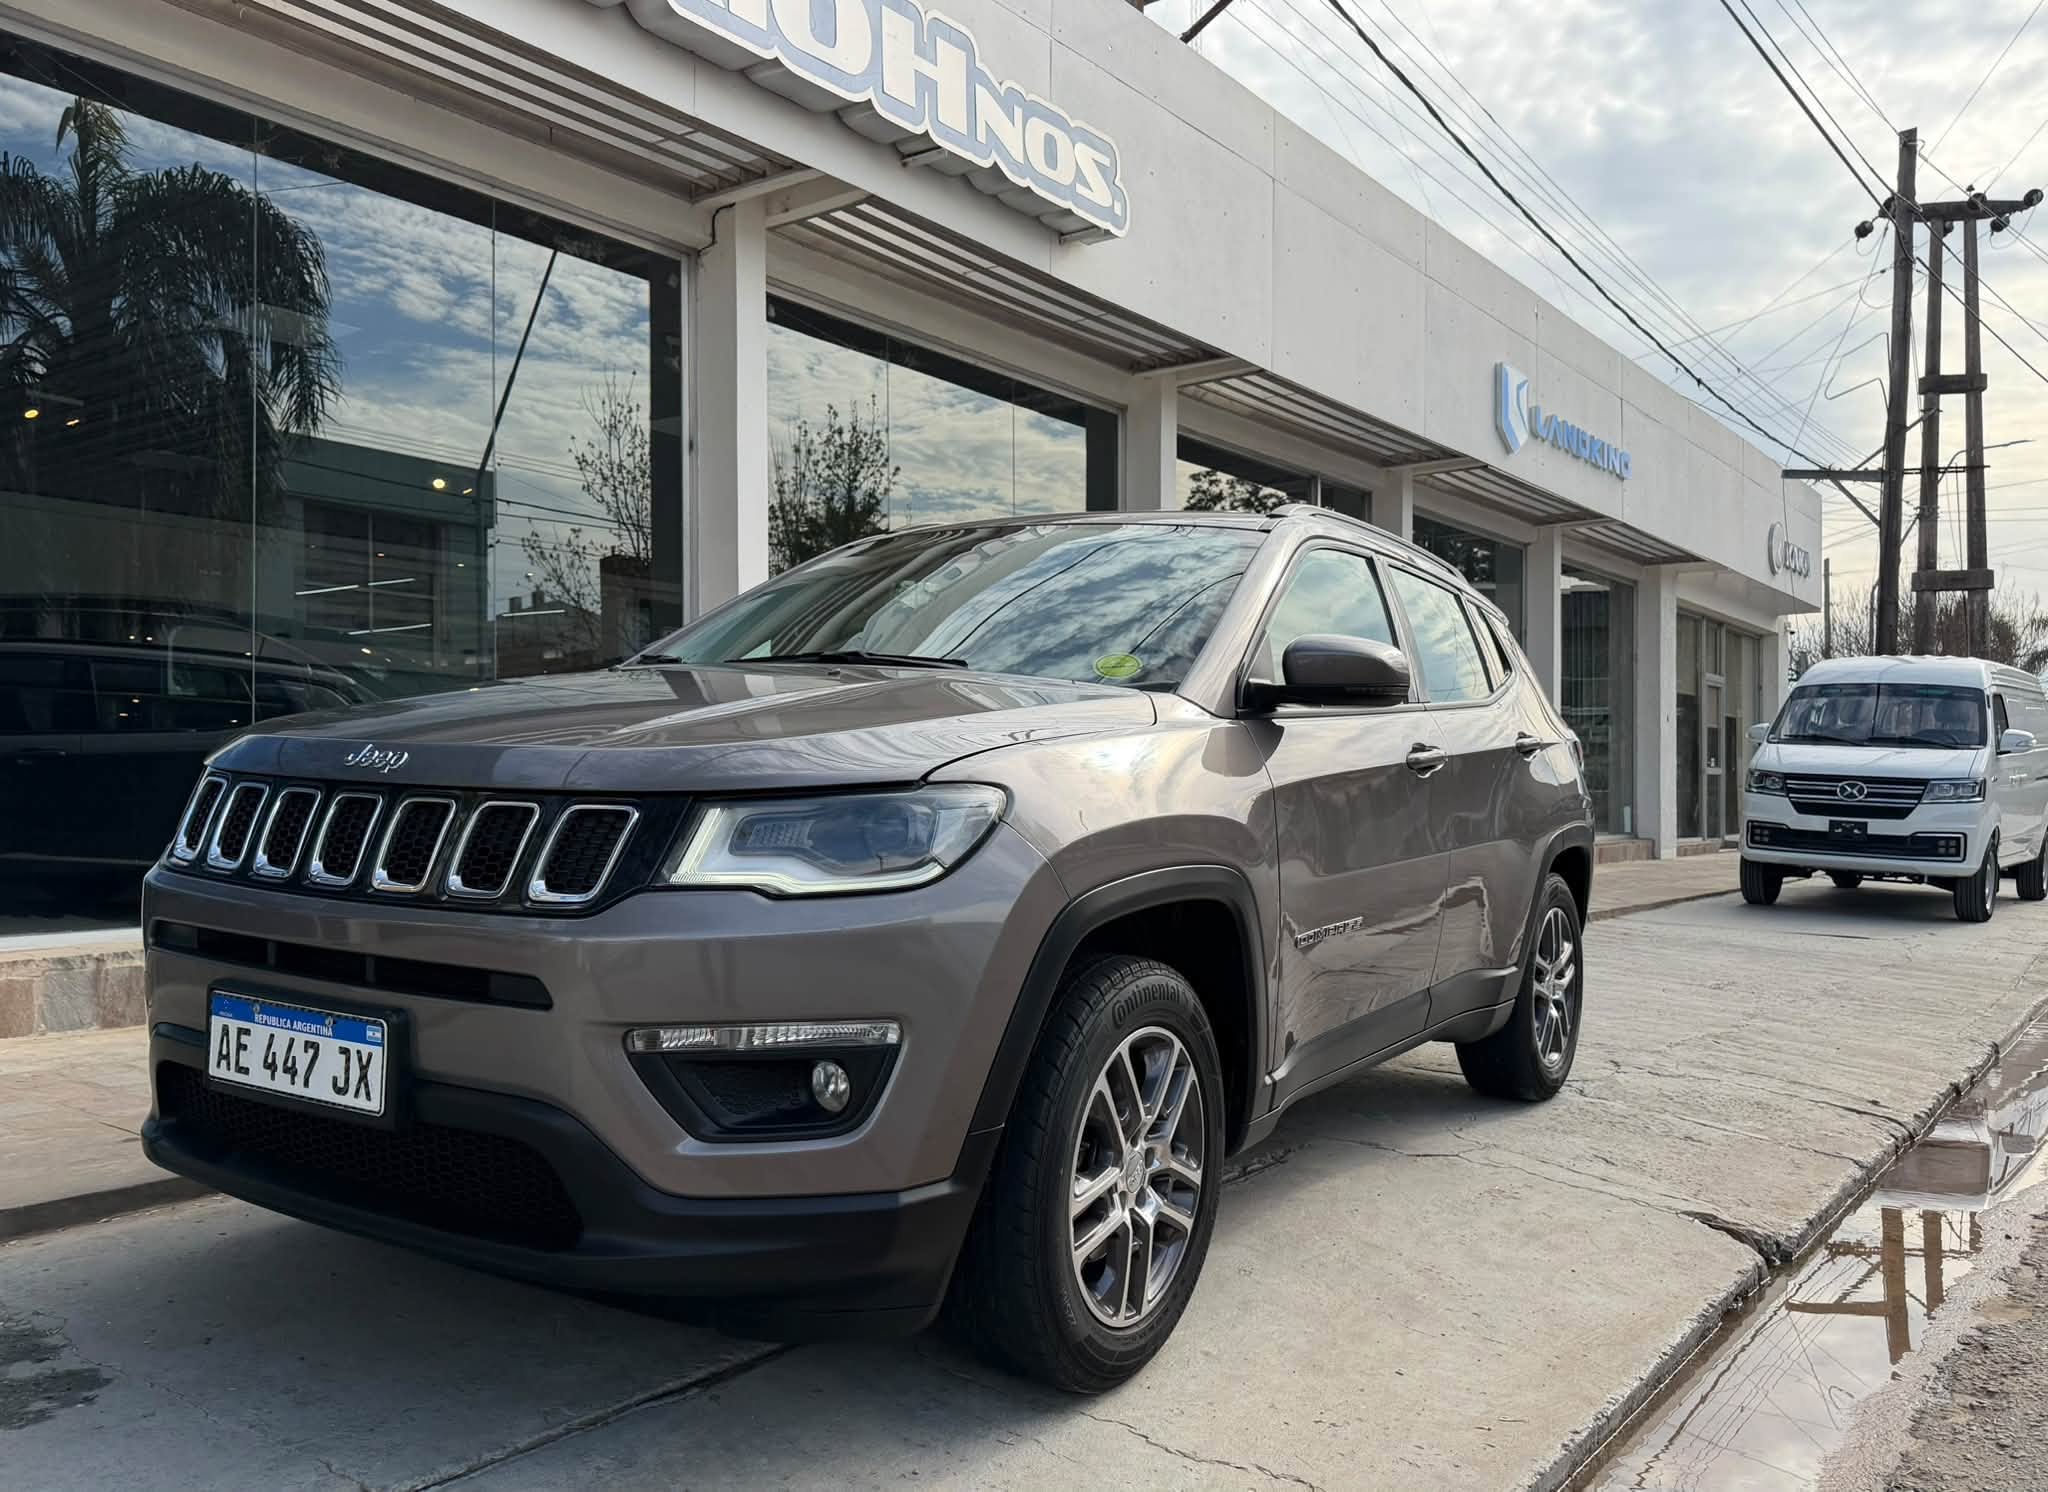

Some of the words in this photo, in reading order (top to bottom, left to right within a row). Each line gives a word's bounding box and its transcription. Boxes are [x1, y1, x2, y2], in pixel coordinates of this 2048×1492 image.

[344, 743, 409, 774] Jeep
[292, 1020, 334, 1038] ARGENTINA
[215, 1023, 252, 1076] AE
[262, 1032, 321, 1089] 447
[331, 1045, 374, 1102] JX
